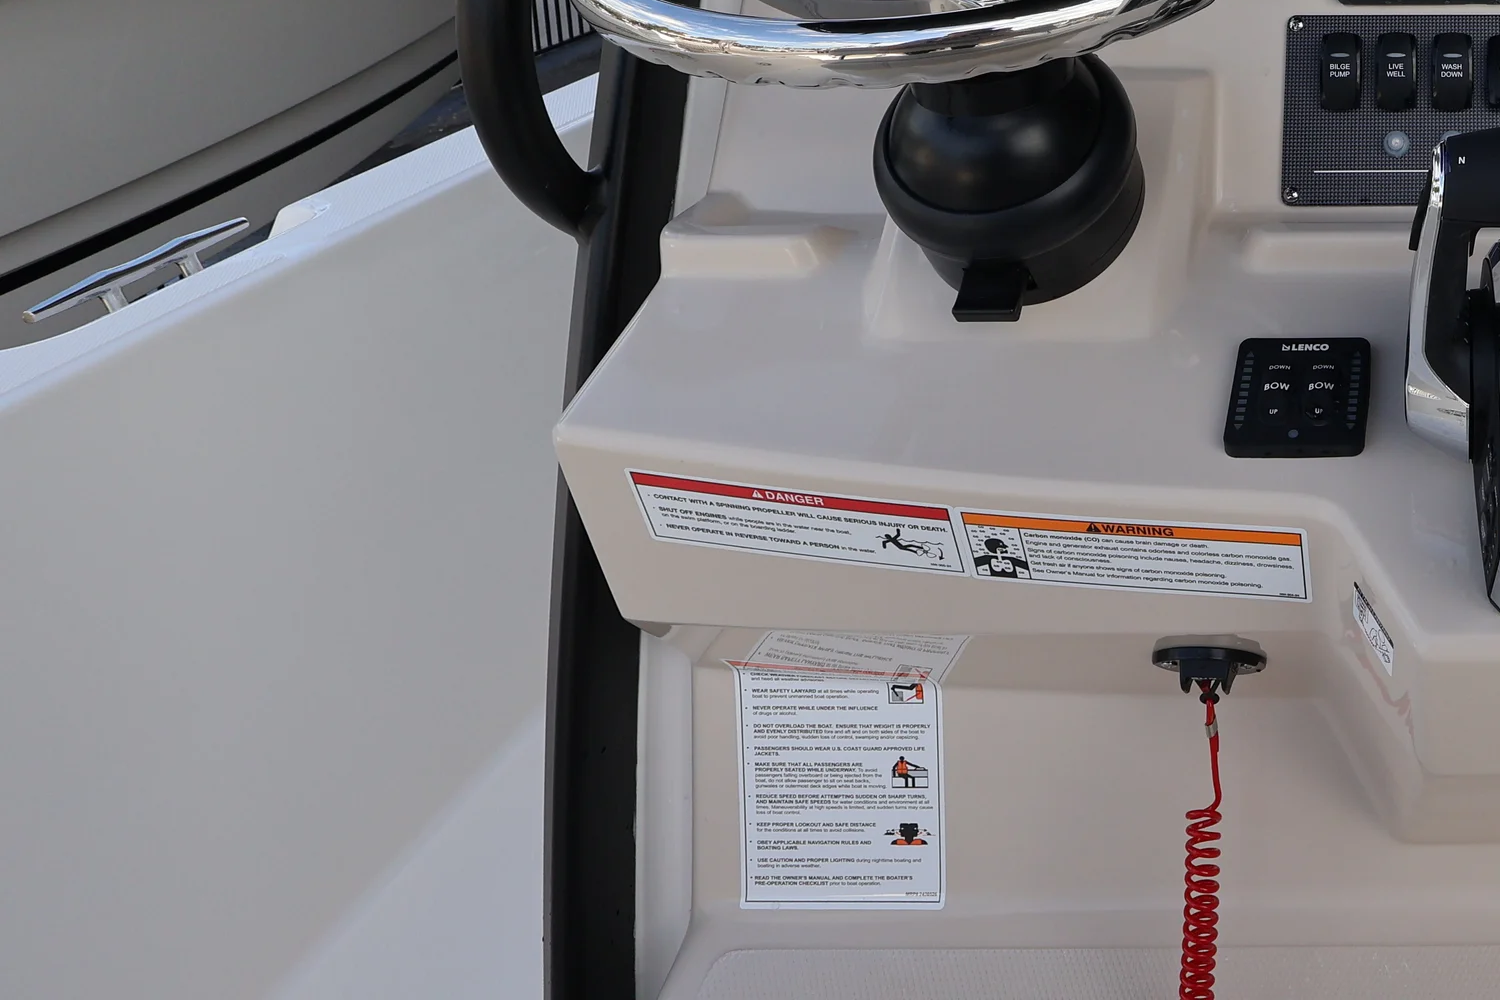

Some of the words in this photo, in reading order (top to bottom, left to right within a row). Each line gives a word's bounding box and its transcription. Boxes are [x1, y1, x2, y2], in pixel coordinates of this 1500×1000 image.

[1458, 157, 1466, 165] N
[1264, 382, 1290, 391] BOW
[1308, 382, 1334, 390] BOW
[765, 491, 824, 505] DANGER
[654, 494, 687, 503] CONTACT
[716, 502, 750, 511] SPINNING
[752, 506, 796, 516] PROPELLER
[843, 517, 877, 526] SERIOUS
[695, 511, 727, 520] ENGINES
[1101, 524, 1174, 536] WARNING
[692, 526, 724, 535] OPERATE
[735, 532, 768, 541] REVERSE
[769, 536, 800, 545] TOWARD
